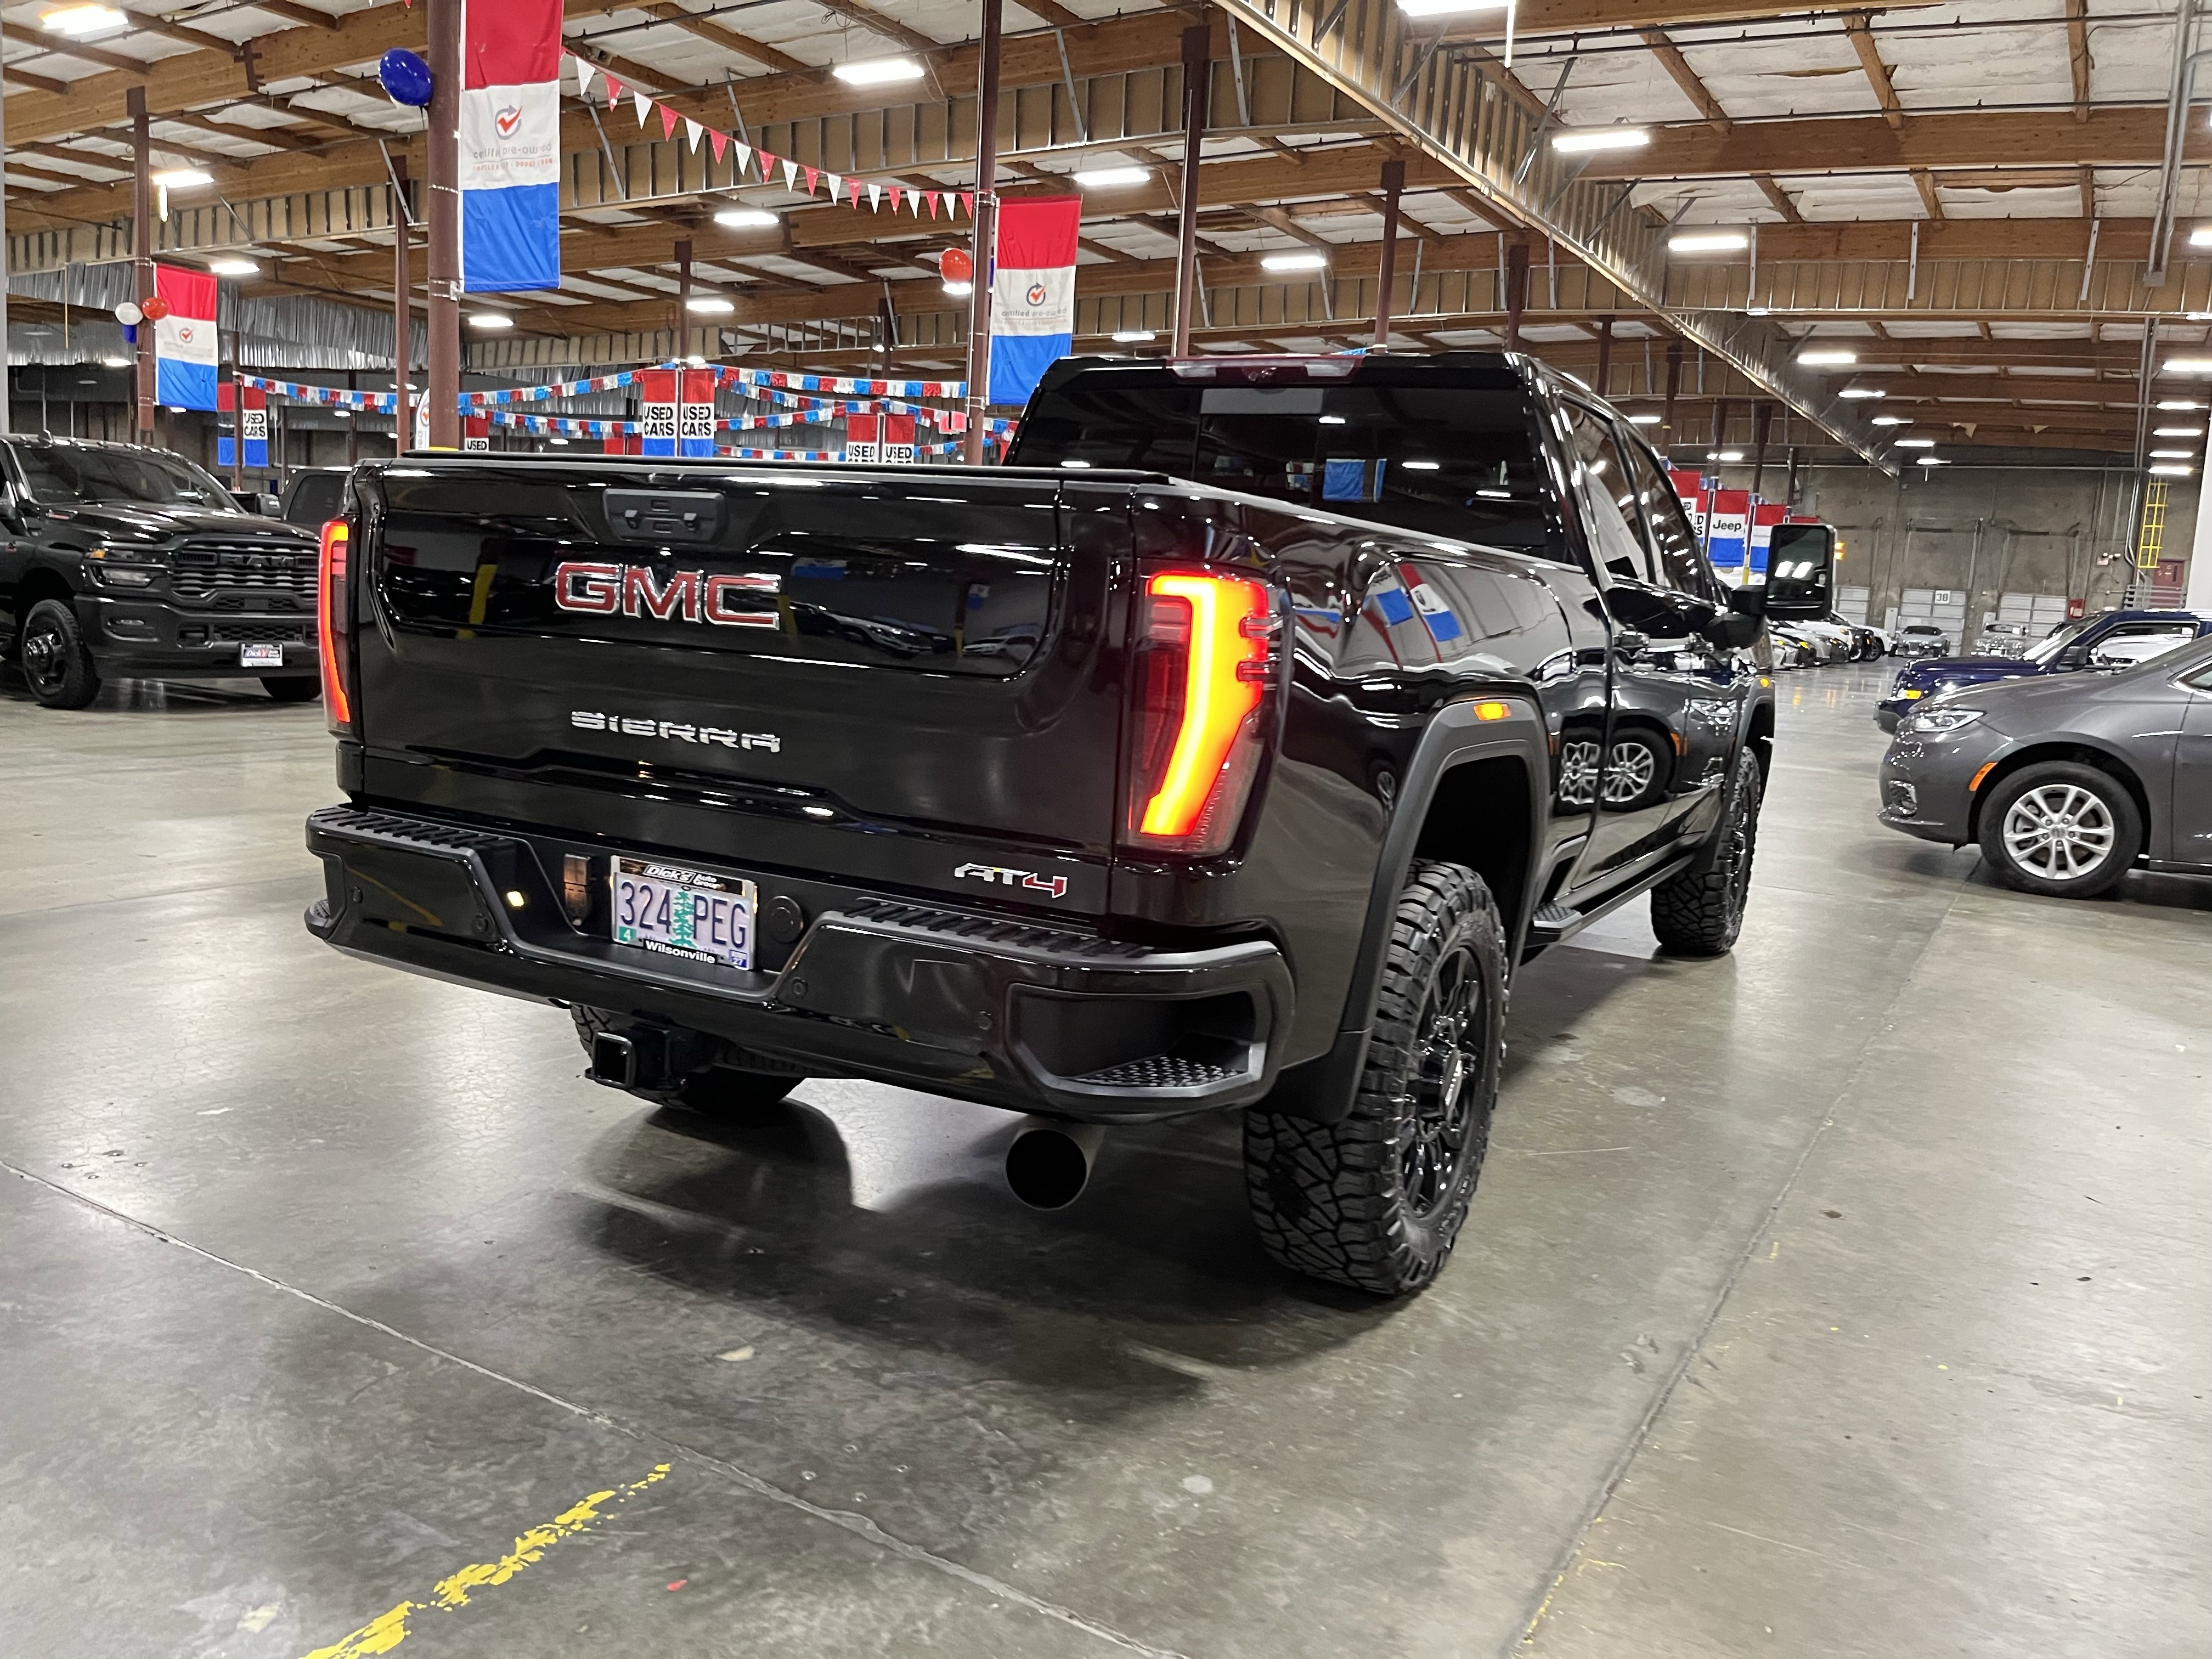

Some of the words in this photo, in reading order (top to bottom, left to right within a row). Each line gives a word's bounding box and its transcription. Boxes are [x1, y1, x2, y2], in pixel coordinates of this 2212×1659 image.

[503, 144, 552, 156] pre-owed
[1032, 307, 1066, 317] pre-owed
[244, 412, 265, 424] USED
[644, 405, 673, 420] USED
[683, 405, 711, 420] USED
[644, 421, 674, 436] CARS
[682, 421, 712, 437] CARS
[467, 439, 487, 450] USED
[848, 444, 875, 458] USED
[885, 445, 912, 459] USED
[1712, 520, 1742, 532] Jeep
[555, 562, 781, 630] GMC
[1936, 593, 1949, 601] 38
[571, 711, 781, 753] SIERRA
[646, 865, 692, 882] Dick's
[697, 873, 717, 883] Auto
[954, 862, 1068, 899] AT4
[620, 881, 672, 934] 324
[693, 894, 747, 949] PEG
[623, 929, 631, 941] 4
[645, 940, 716, 964] Wilsonville
